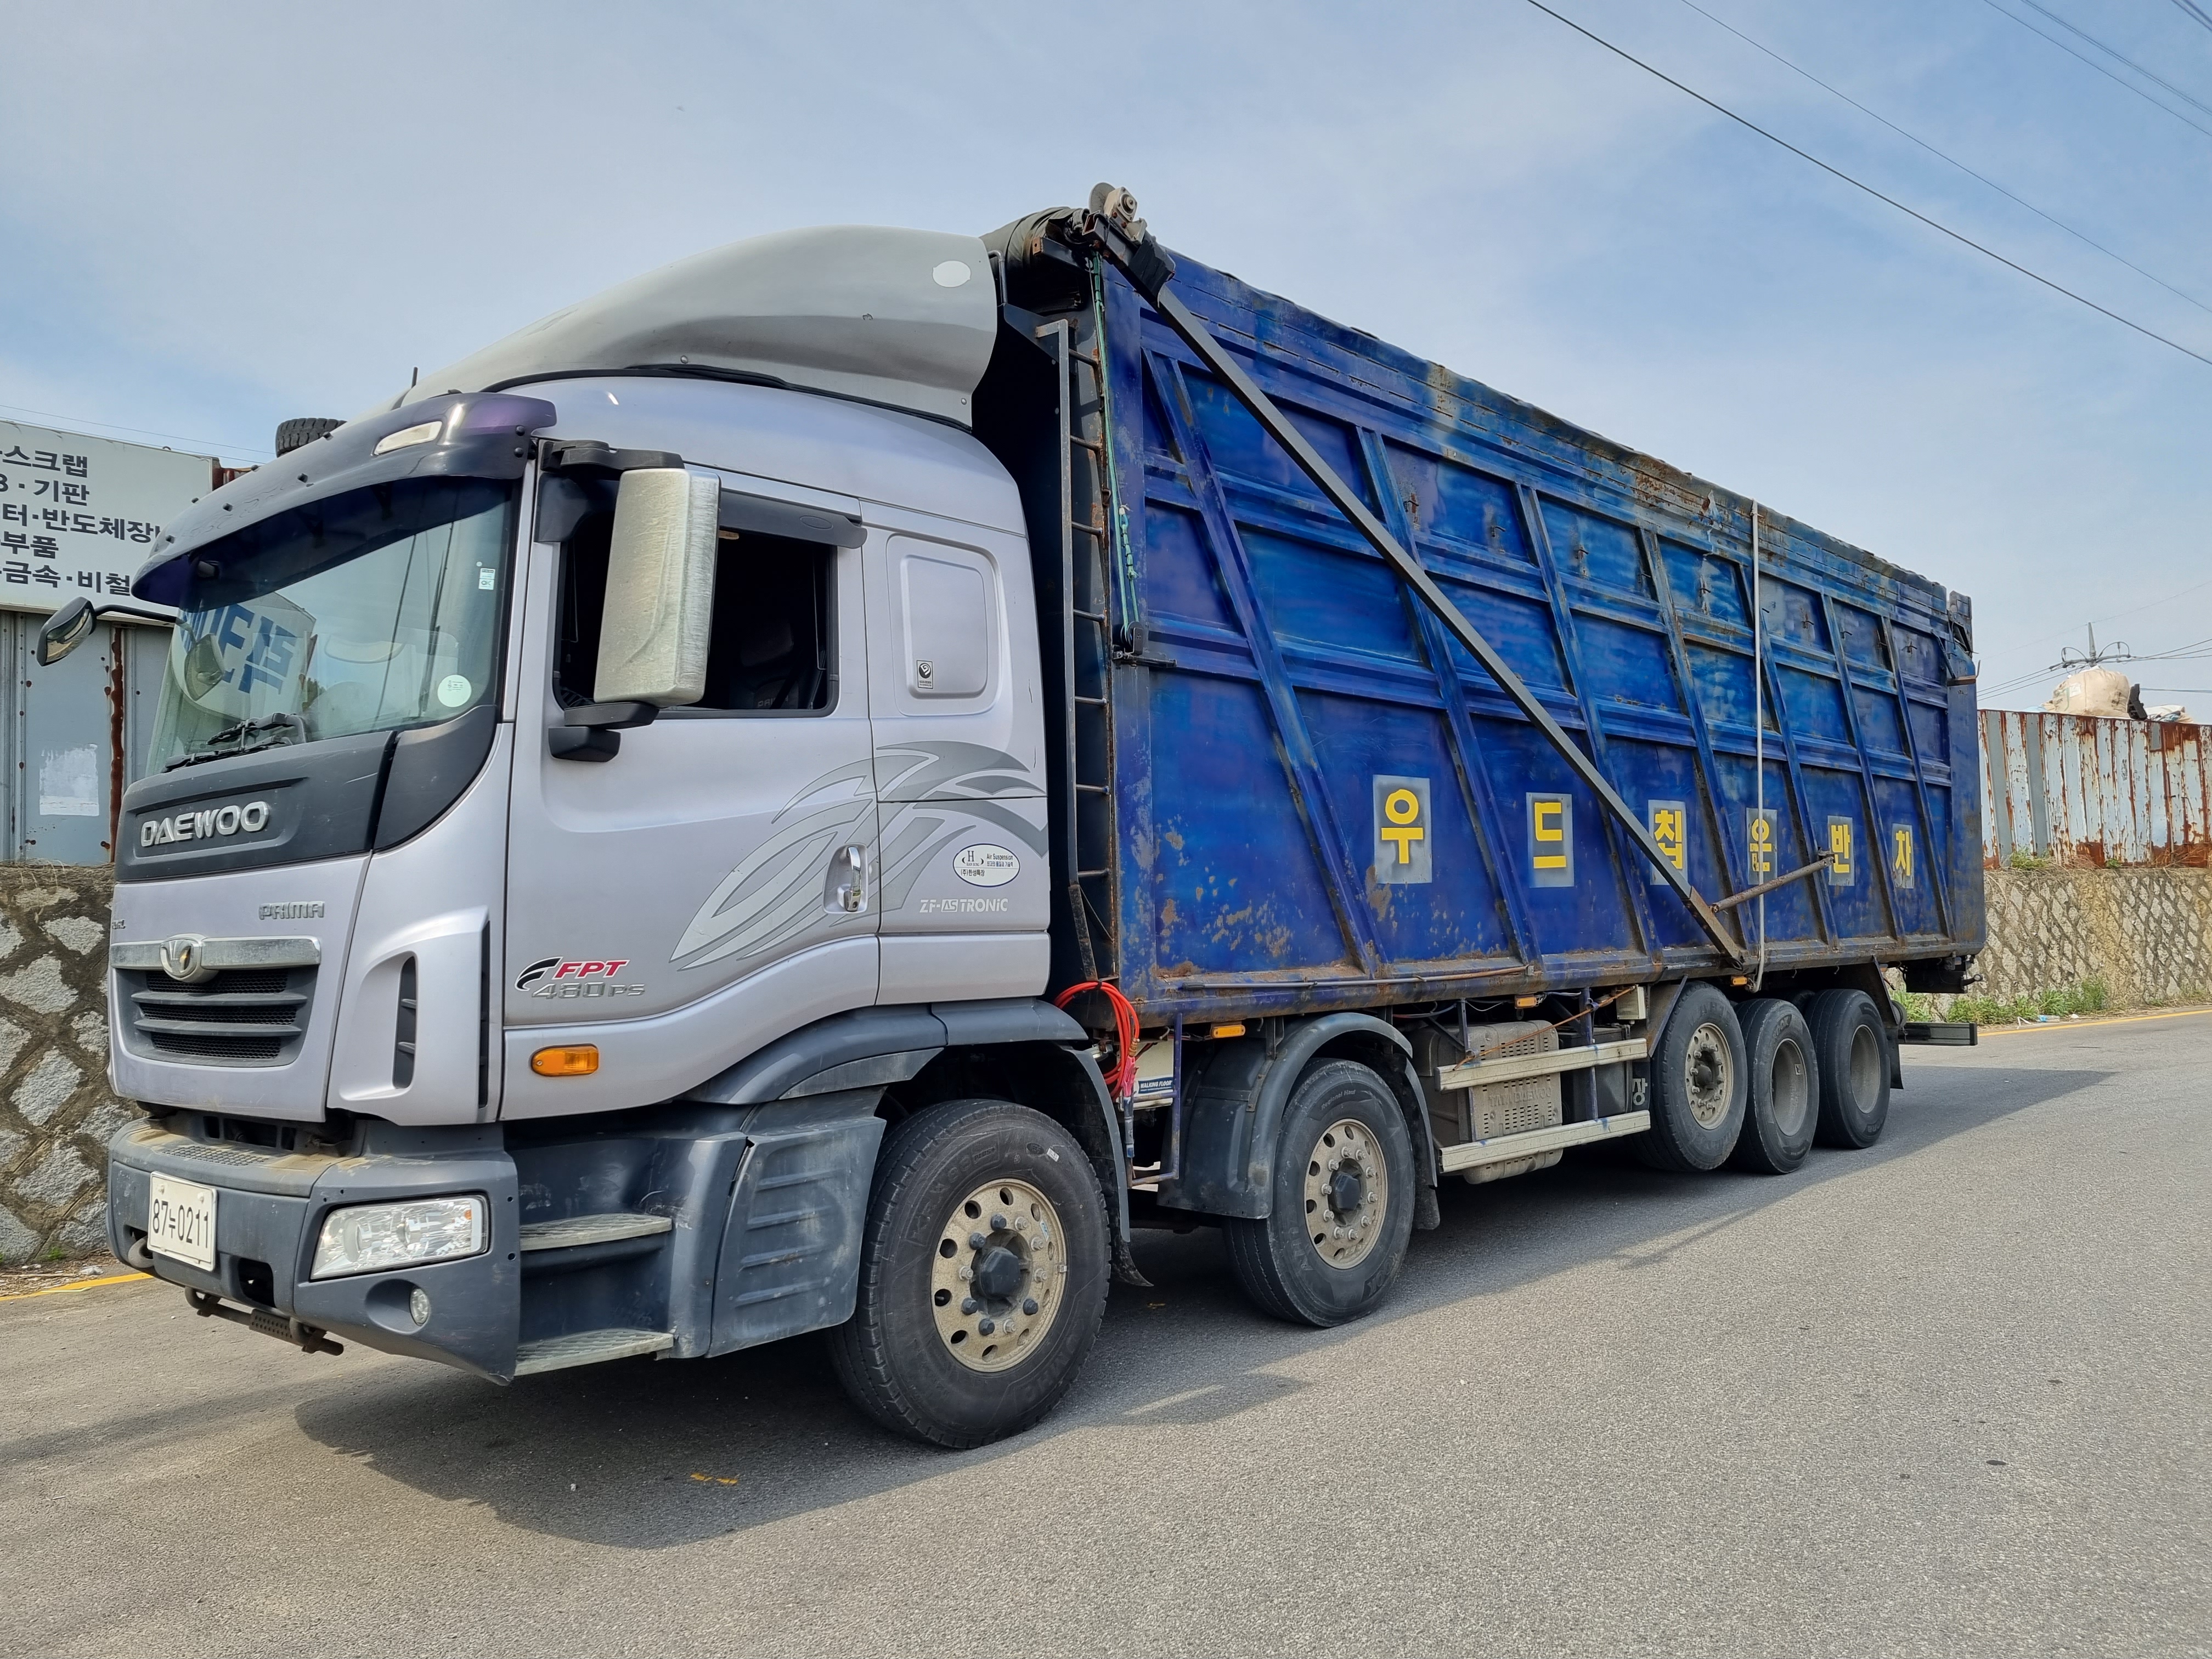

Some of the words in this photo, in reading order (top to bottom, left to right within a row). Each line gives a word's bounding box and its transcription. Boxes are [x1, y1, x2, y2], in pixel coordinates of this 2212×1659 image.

[0, 445, 88, 478] 스크랩
[0, 561, 131, 596] 금속·비철
[141, 801, 270, 847] DAEWOO
[258, 900, 325, 920] PRIMA
[552, 959, 630, 980] FPT
[1321, 1092, 1342, 1110] Regional
[152, 1198, 209, 1249] 87누0211
